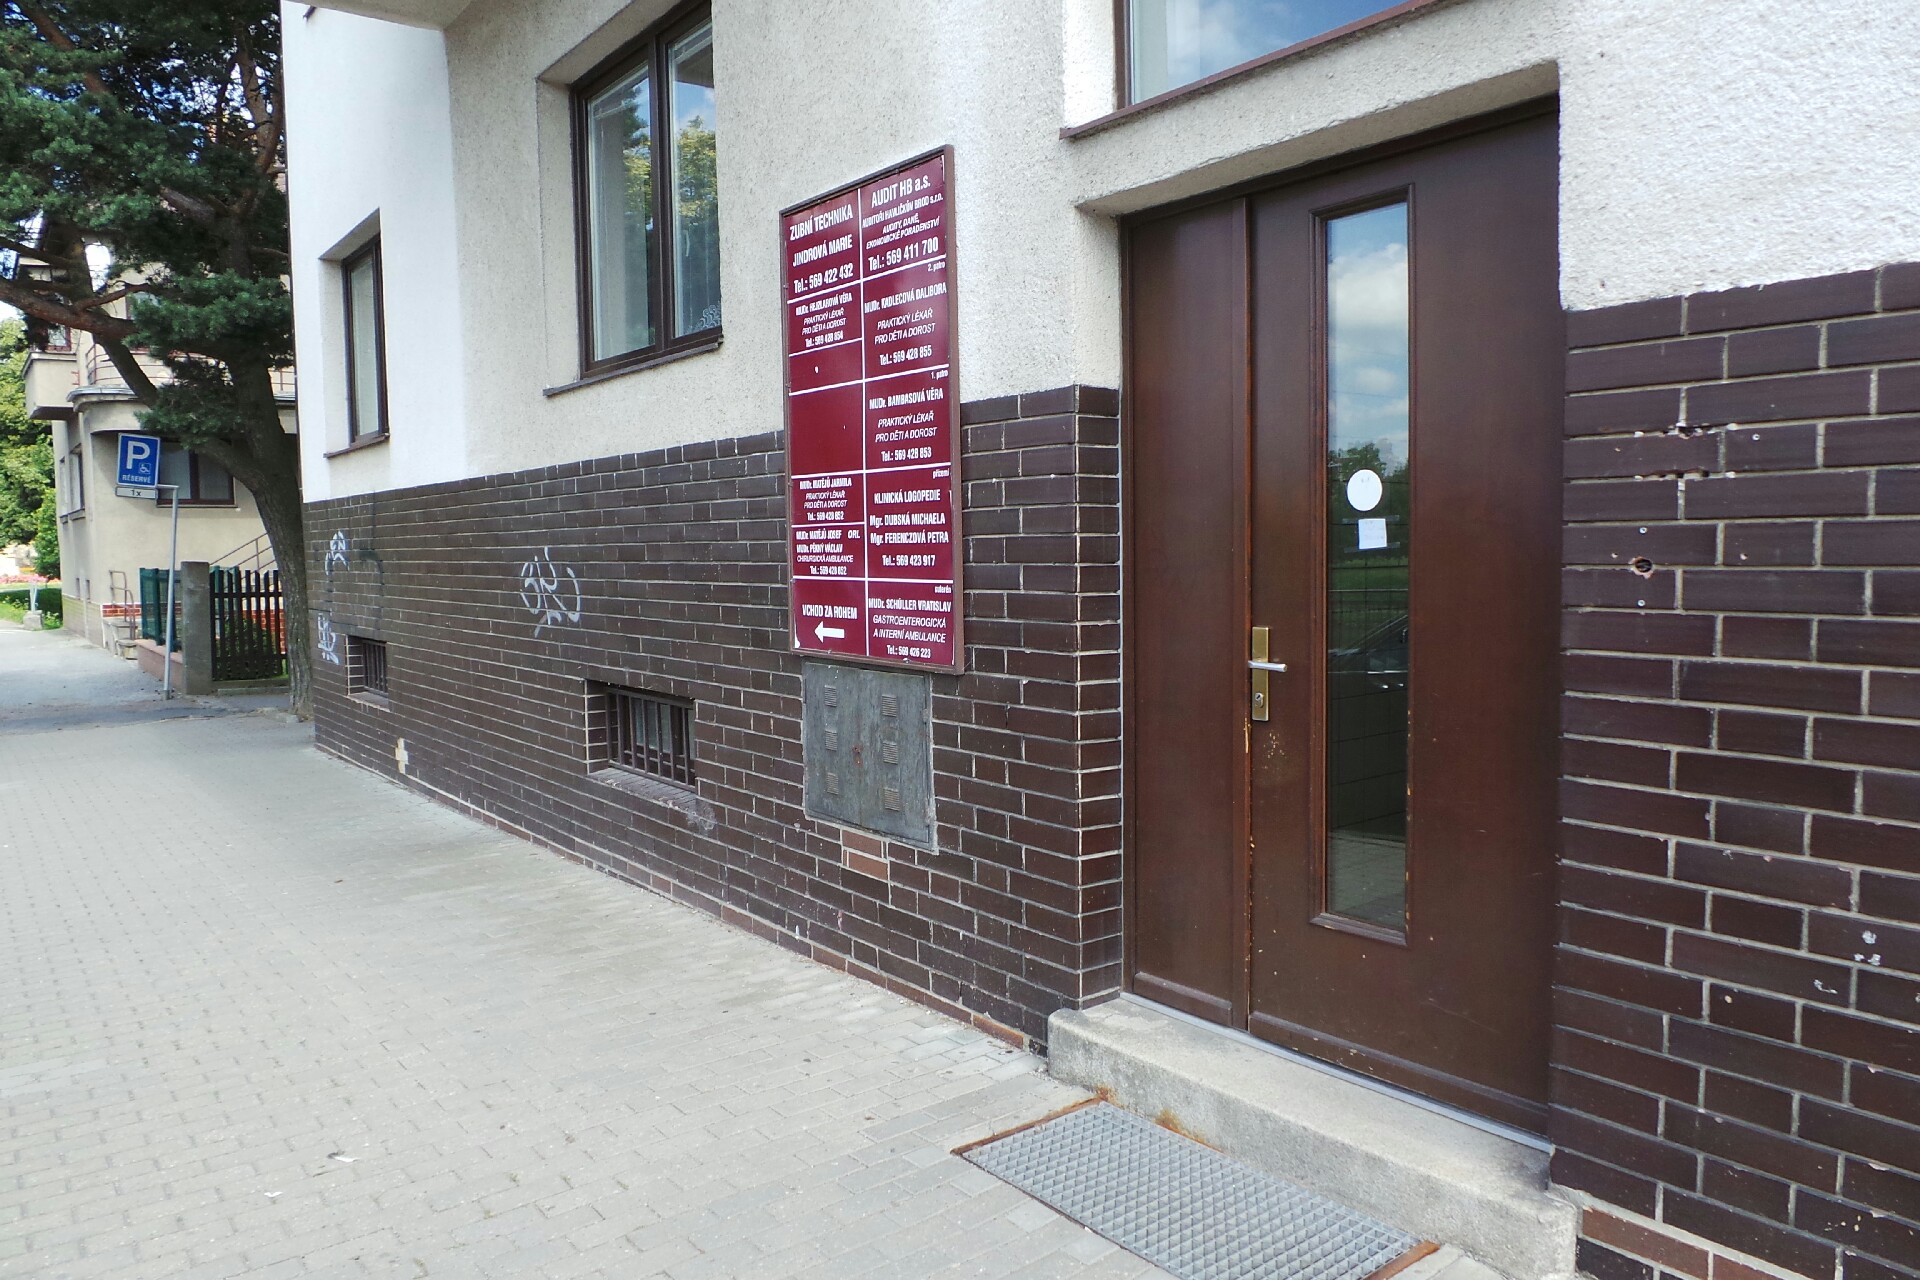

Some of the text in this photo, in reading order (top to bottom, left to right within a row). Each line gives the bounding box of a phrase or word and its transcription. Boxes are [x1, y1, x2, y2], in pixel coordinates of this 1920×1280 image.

[872, 175, 930, 208] AUDIT HB a.s.
[915, 196, 929, 209] BROD
[930, 193, 943, 203] s.r.o.
[790, 204, 853, 240] ZUBNÍ TECHNIKA
[900, 216, 940, 238] PORADENSTVÍ
[793, 234, 852, 267] JINDROVÁ MARIE
[868, 237, 938, 271] Tel.: 569 411 700
[794, 263, 853, 293] Tel.: 569 422 432
[865, 282, 947, 313] MUDr. KADLECOVÁ DALIBORA
[804, 311, 828, 325] PRAKTICKÝ
[812, 322, 822, 333] DĚTI
[827, 318, 846, 329] DOROST
[877, 307, 933, 330] PRAKTICKÝ LÉKAŘ
[875, 323, 935, 344] PRO DĚTI A DOROST
[880, 345, 932, 365] Tel.: 569 428 855
[870, 387, 943, 409] MUDr. BAMBASOVÁ VĚRA
[878, 410, 934, 428] PRAKTICKÝ LÉKAŘ
[875, 427, 937, 442] PRO DĚTI A DOROST
[126, 440, 150, 470] P
[881, 447, 931, 461] Tel.: 569 428 853
[806, 491, 829, 500] PRAKTICKÝ
[874, 489, 940, 504] KLINICKÁ LOGOPEDIE
[814, 500, 823, 508] DĚTI
[870, 511, 945, 528] Mgr. DUBSKÁ MICHAELA
[828, 530, 842, 539] JOSEF
[848, 530, 860, 538] ORL
[870, 529, 949, 546] Mgr. FERENCZOVÁ PETRA
[825, 542, 842, 552] VÁCLAV
[882, 555, 935, 566] Tel.: 569 423 917
[802, 604, 857, 619] VCHOD ZA ROHEM
[869, 598, 885, 608] MUDr.
[918, 600, 951, 612] VRATISLAV
[873, 615, 946, 628] GASTROENTEROGICKÁ
[873, 629, 946, 643] A INTERNÍ AMBULANCE
[887, 645, 897, 655] Tel.:
[899, 646, 908, 655] 569
[921, 648, 930, 658] 223
